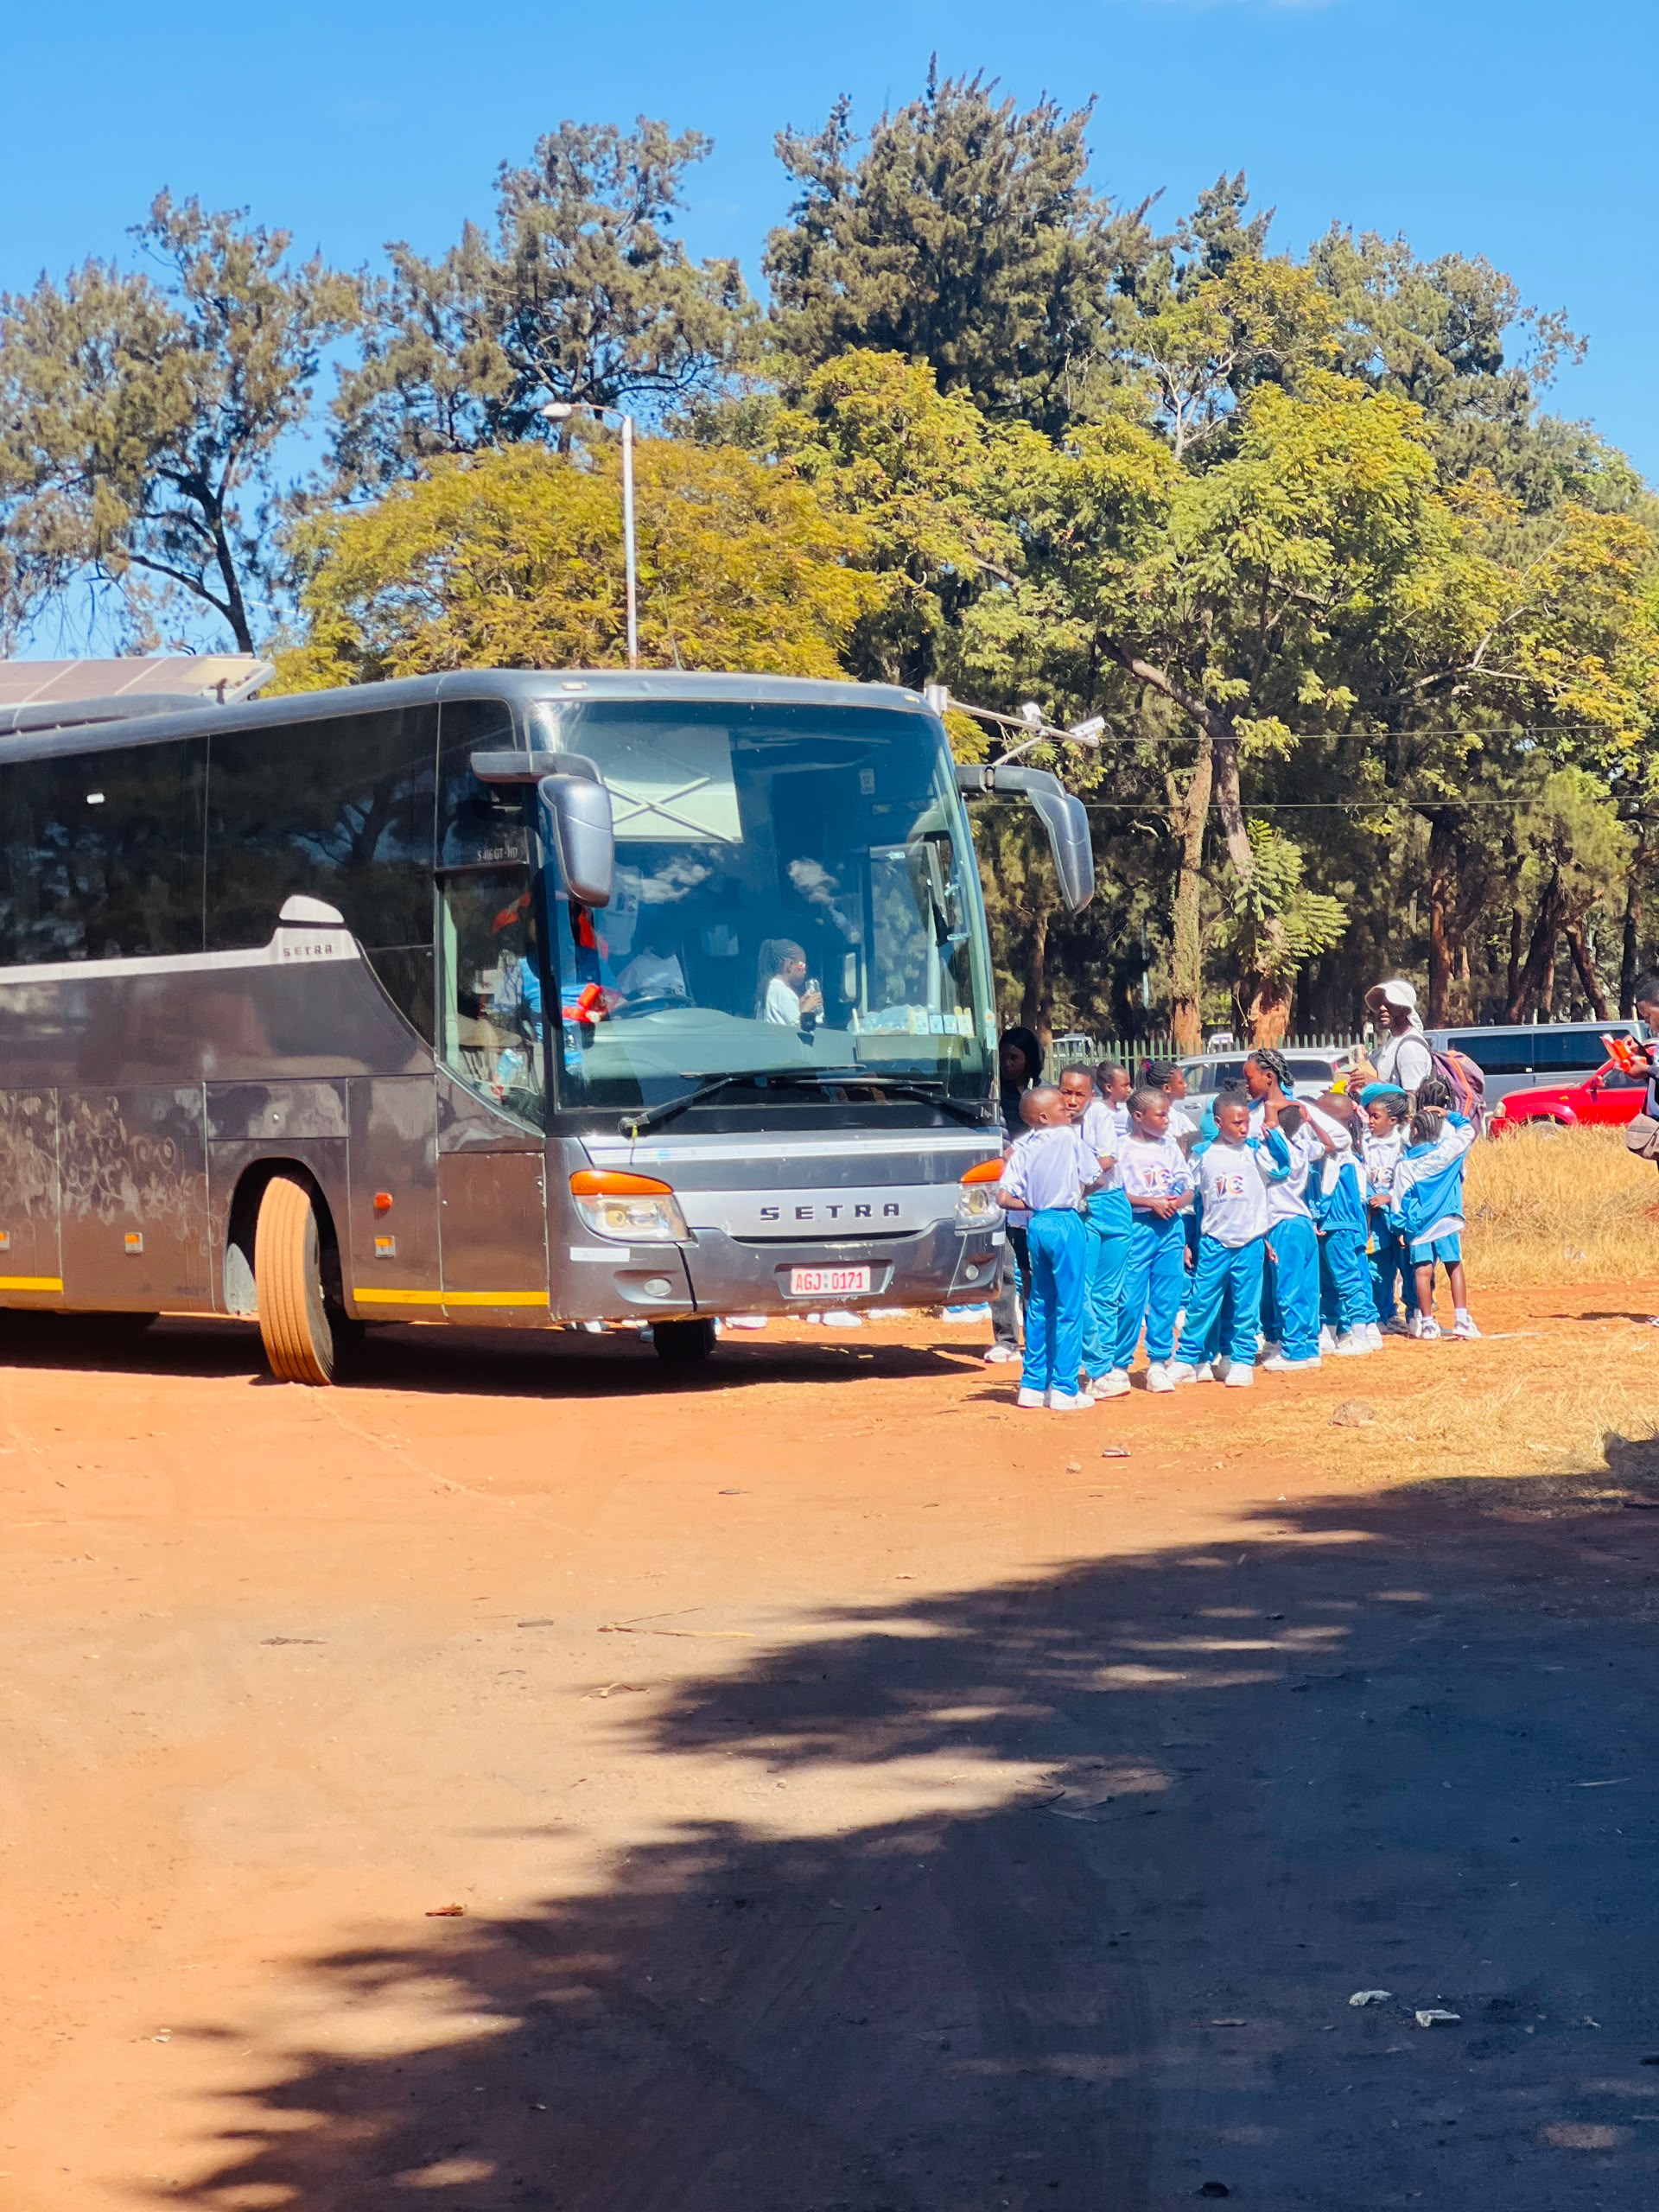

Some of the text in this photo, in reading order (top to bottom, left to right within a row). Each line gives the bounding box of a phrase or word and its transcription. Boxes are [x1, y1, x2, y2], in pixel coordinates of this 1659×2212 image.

[283, 944, 333, 957] SETRA
[760, 1203, 899, 1221] SETRA
[795, 1272, 863, 1291] AGJ 0171
